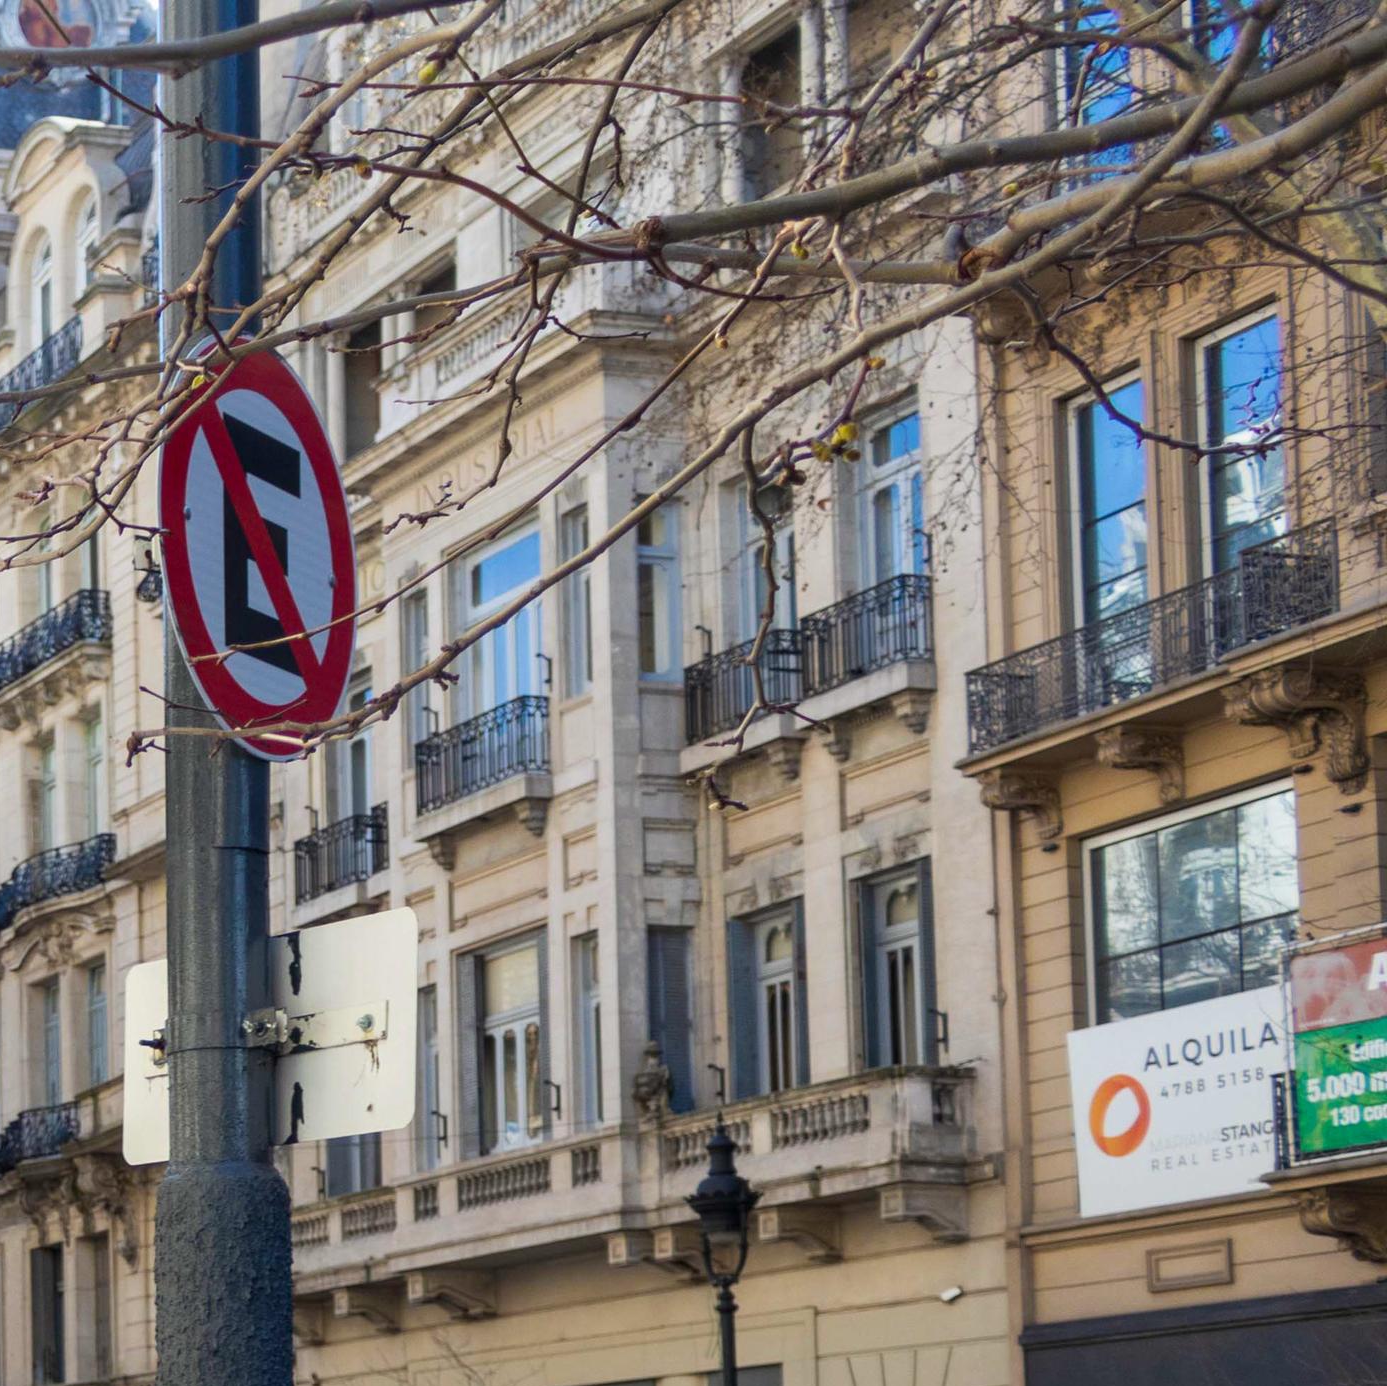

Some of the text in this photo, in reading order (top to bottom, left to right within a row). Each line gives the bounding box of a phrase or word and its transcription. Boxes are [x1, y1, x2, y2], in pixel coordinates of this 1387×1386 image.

[1143, 1022, 1279, 1072] ALQUILA
[1160, 1067, 1265, 1099] 4788 5158
[1307, 1071, 1366, 1103] 5.000
[1329, 1104, 1361, 1127] 130
[1151, 1153, 1199, 1172] REAL
